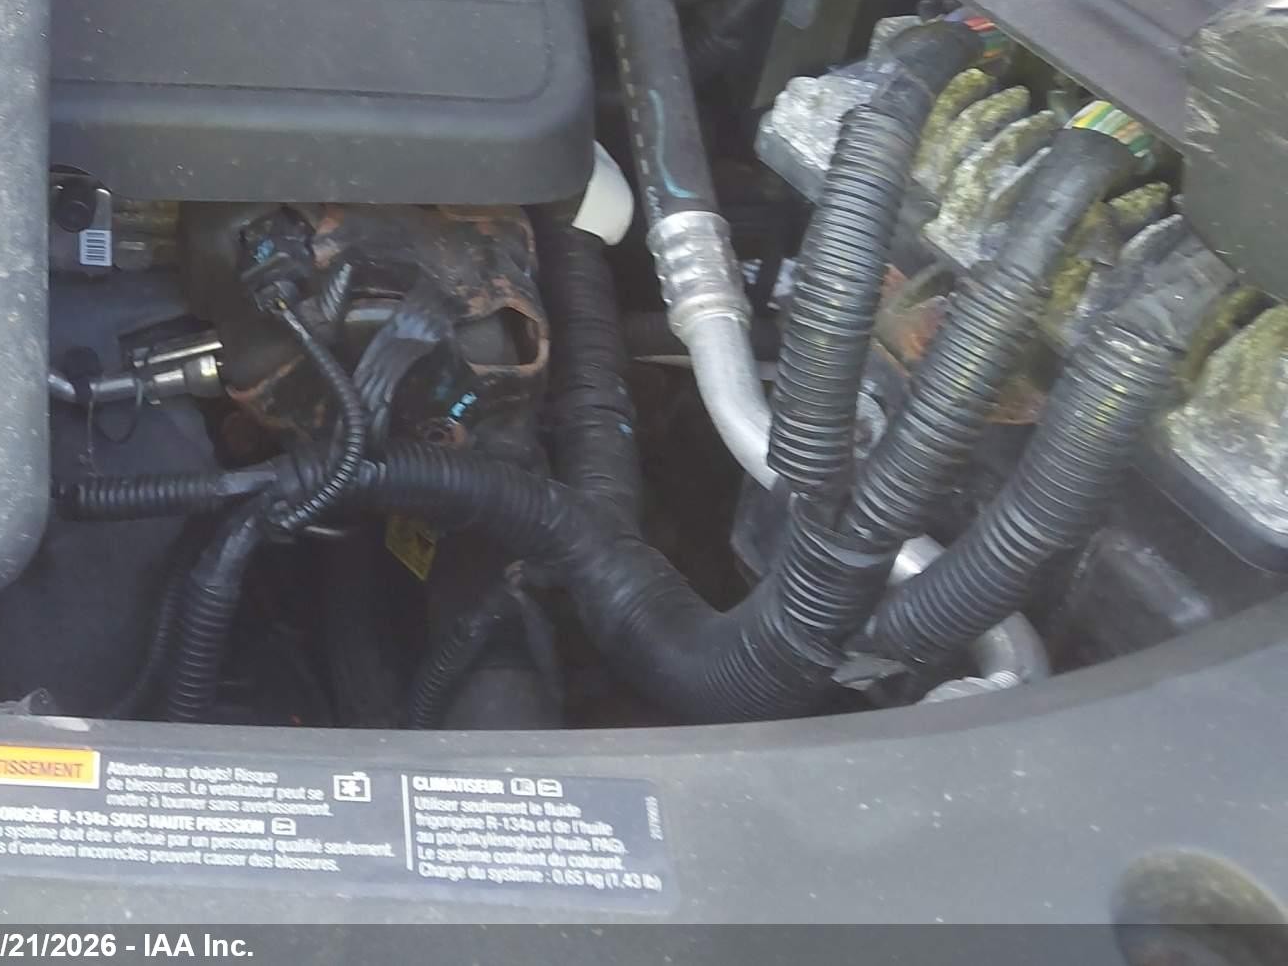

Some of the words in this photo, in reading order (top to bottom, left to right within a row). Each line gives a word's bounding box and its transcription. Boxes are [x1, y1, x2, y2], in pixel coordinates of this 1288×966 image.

[107, 761, 162, 777] Attention
[164, 766, 188, 778] aux
[234, 767, 278, 785] Risque
[107, 777, 123, 790] de
[125, 778, 189, 794] blessures.
[190, 781, 208, 795] Le
[209, 783, 274, 798] ventilateur
[276, 786, 306, 801] peut
[307, 788, 324, 800] se
[413, 776, 504, 794] CLIMATISEUR
[106, 793, 148, 807] mettre
[149, 794, 160, 808] à
[161, 796, 206, 810] tourner
[207, 800, 239, 811] sans
[414, 796, 458, 812] Utiliser
[460, 800, 528, 815] seulement
[528, 801, 543, 816] le
[543, 802, 581, 818] fluide
[59, 809, 109, 826] R-134a
[110, 813, 147, 828] SOUS
[149, 815, 195, 831] HAUTE
[196, 817, 265, 834] PRESSION
[415, 812, 485, 831] frigorigène
[486, 815, 536, 832] R-134a
[537, 819, 551, 833] et
[552, 819, 571, 834] de
[5, 826, 58, 842] système
[60, 827, 84, 841] doit
[86, 828, 112, 843] être
[114, 830, 165, 845] effectué
[167, 835, 190, 848] par
[191, 836, 209, 848] un
[211, 837, 273, 852] personnel
[275, 838, 322, 854] qualifié
[416, 831, 434, 844] au
[553, 836, 591, 852] (huile
[8, 840, 76, 857] d'entretien
[78, 844, 148, 862] incorrectes
[150, 849, 202, 865] peuvent
[203, 853, 247, 866] causer
[248, 853, 273, 868] des
[417, 845, 435, 860] Le
[436, 846, 492, 863] système
[493, 851, 548, 866] contient
[547, 852, 567, 867] du
[419, 861, 466, 882] Charge
[467, 865, 486, 880] du
[487, 866, 544, 884] système
[584, 871, 605, 890] kg
